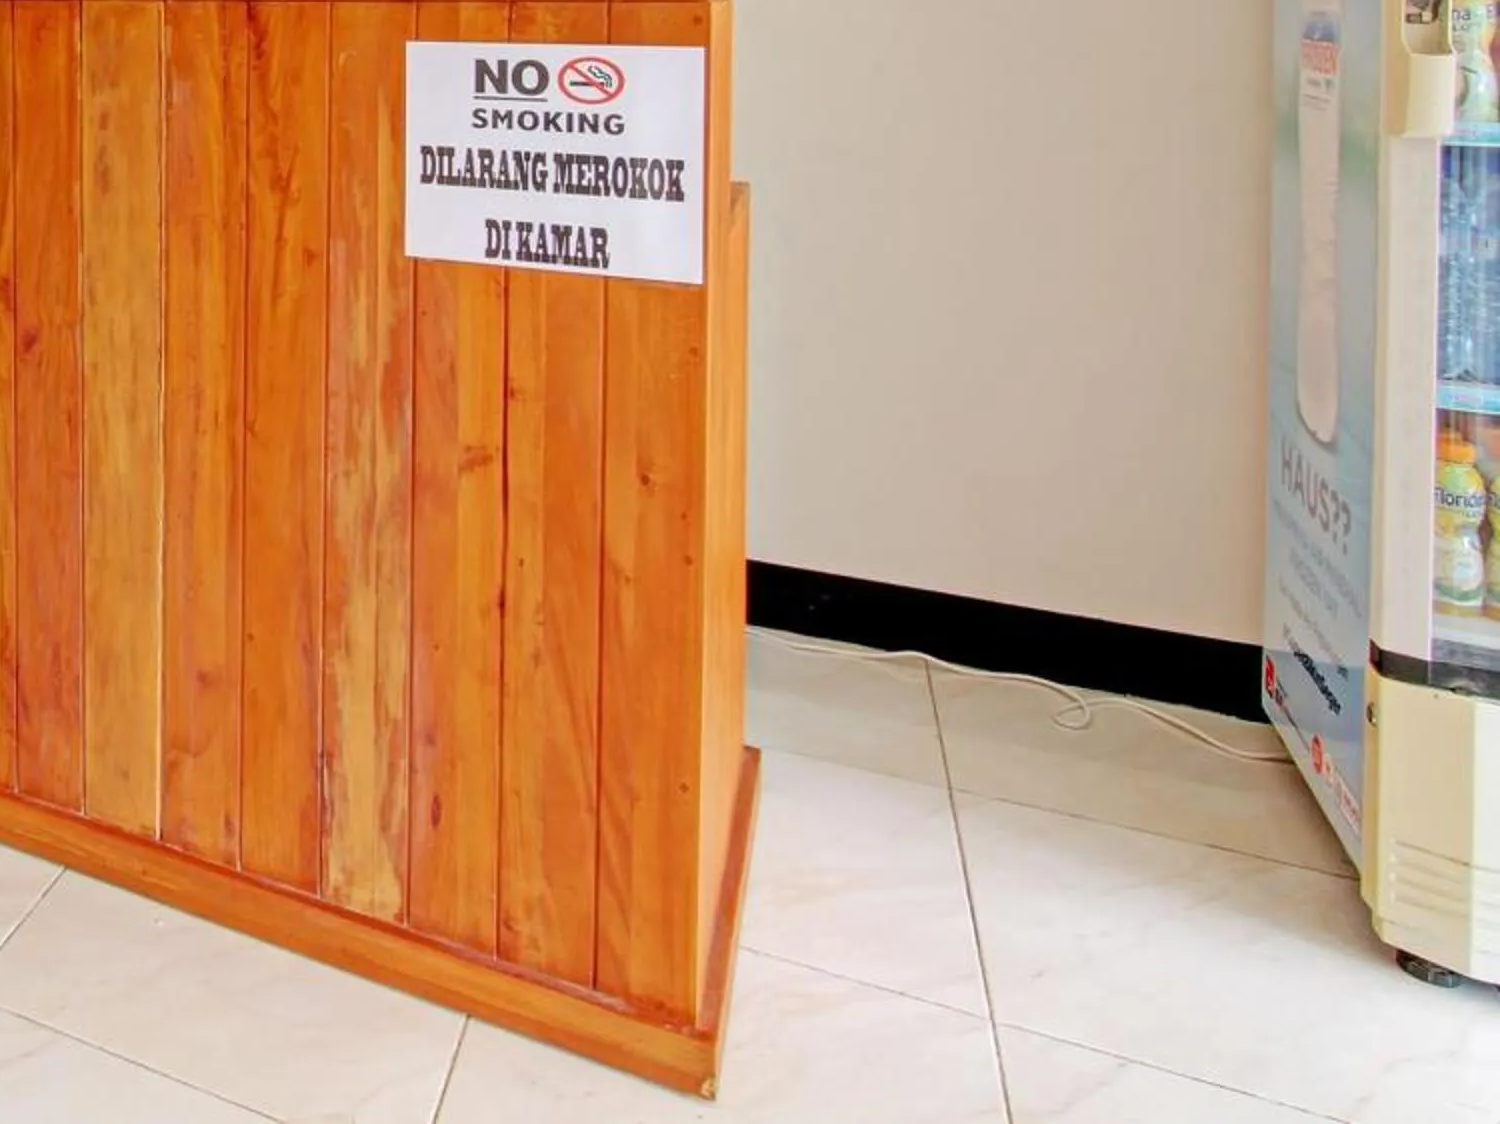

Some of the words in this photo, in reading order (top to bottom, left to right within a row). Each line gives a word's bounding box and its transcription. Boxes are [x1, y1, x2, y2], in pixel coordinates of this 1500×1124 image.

[474, 58, 550, 97] NO
[471, 107, 625, 136] SMOKING
[419, 145, 549, 193] DILARANG
[553, 152, 685, 203] MEROKOK
[484, 218, 512, 261] DI
[515, 221, 611, 270] KAMAR
